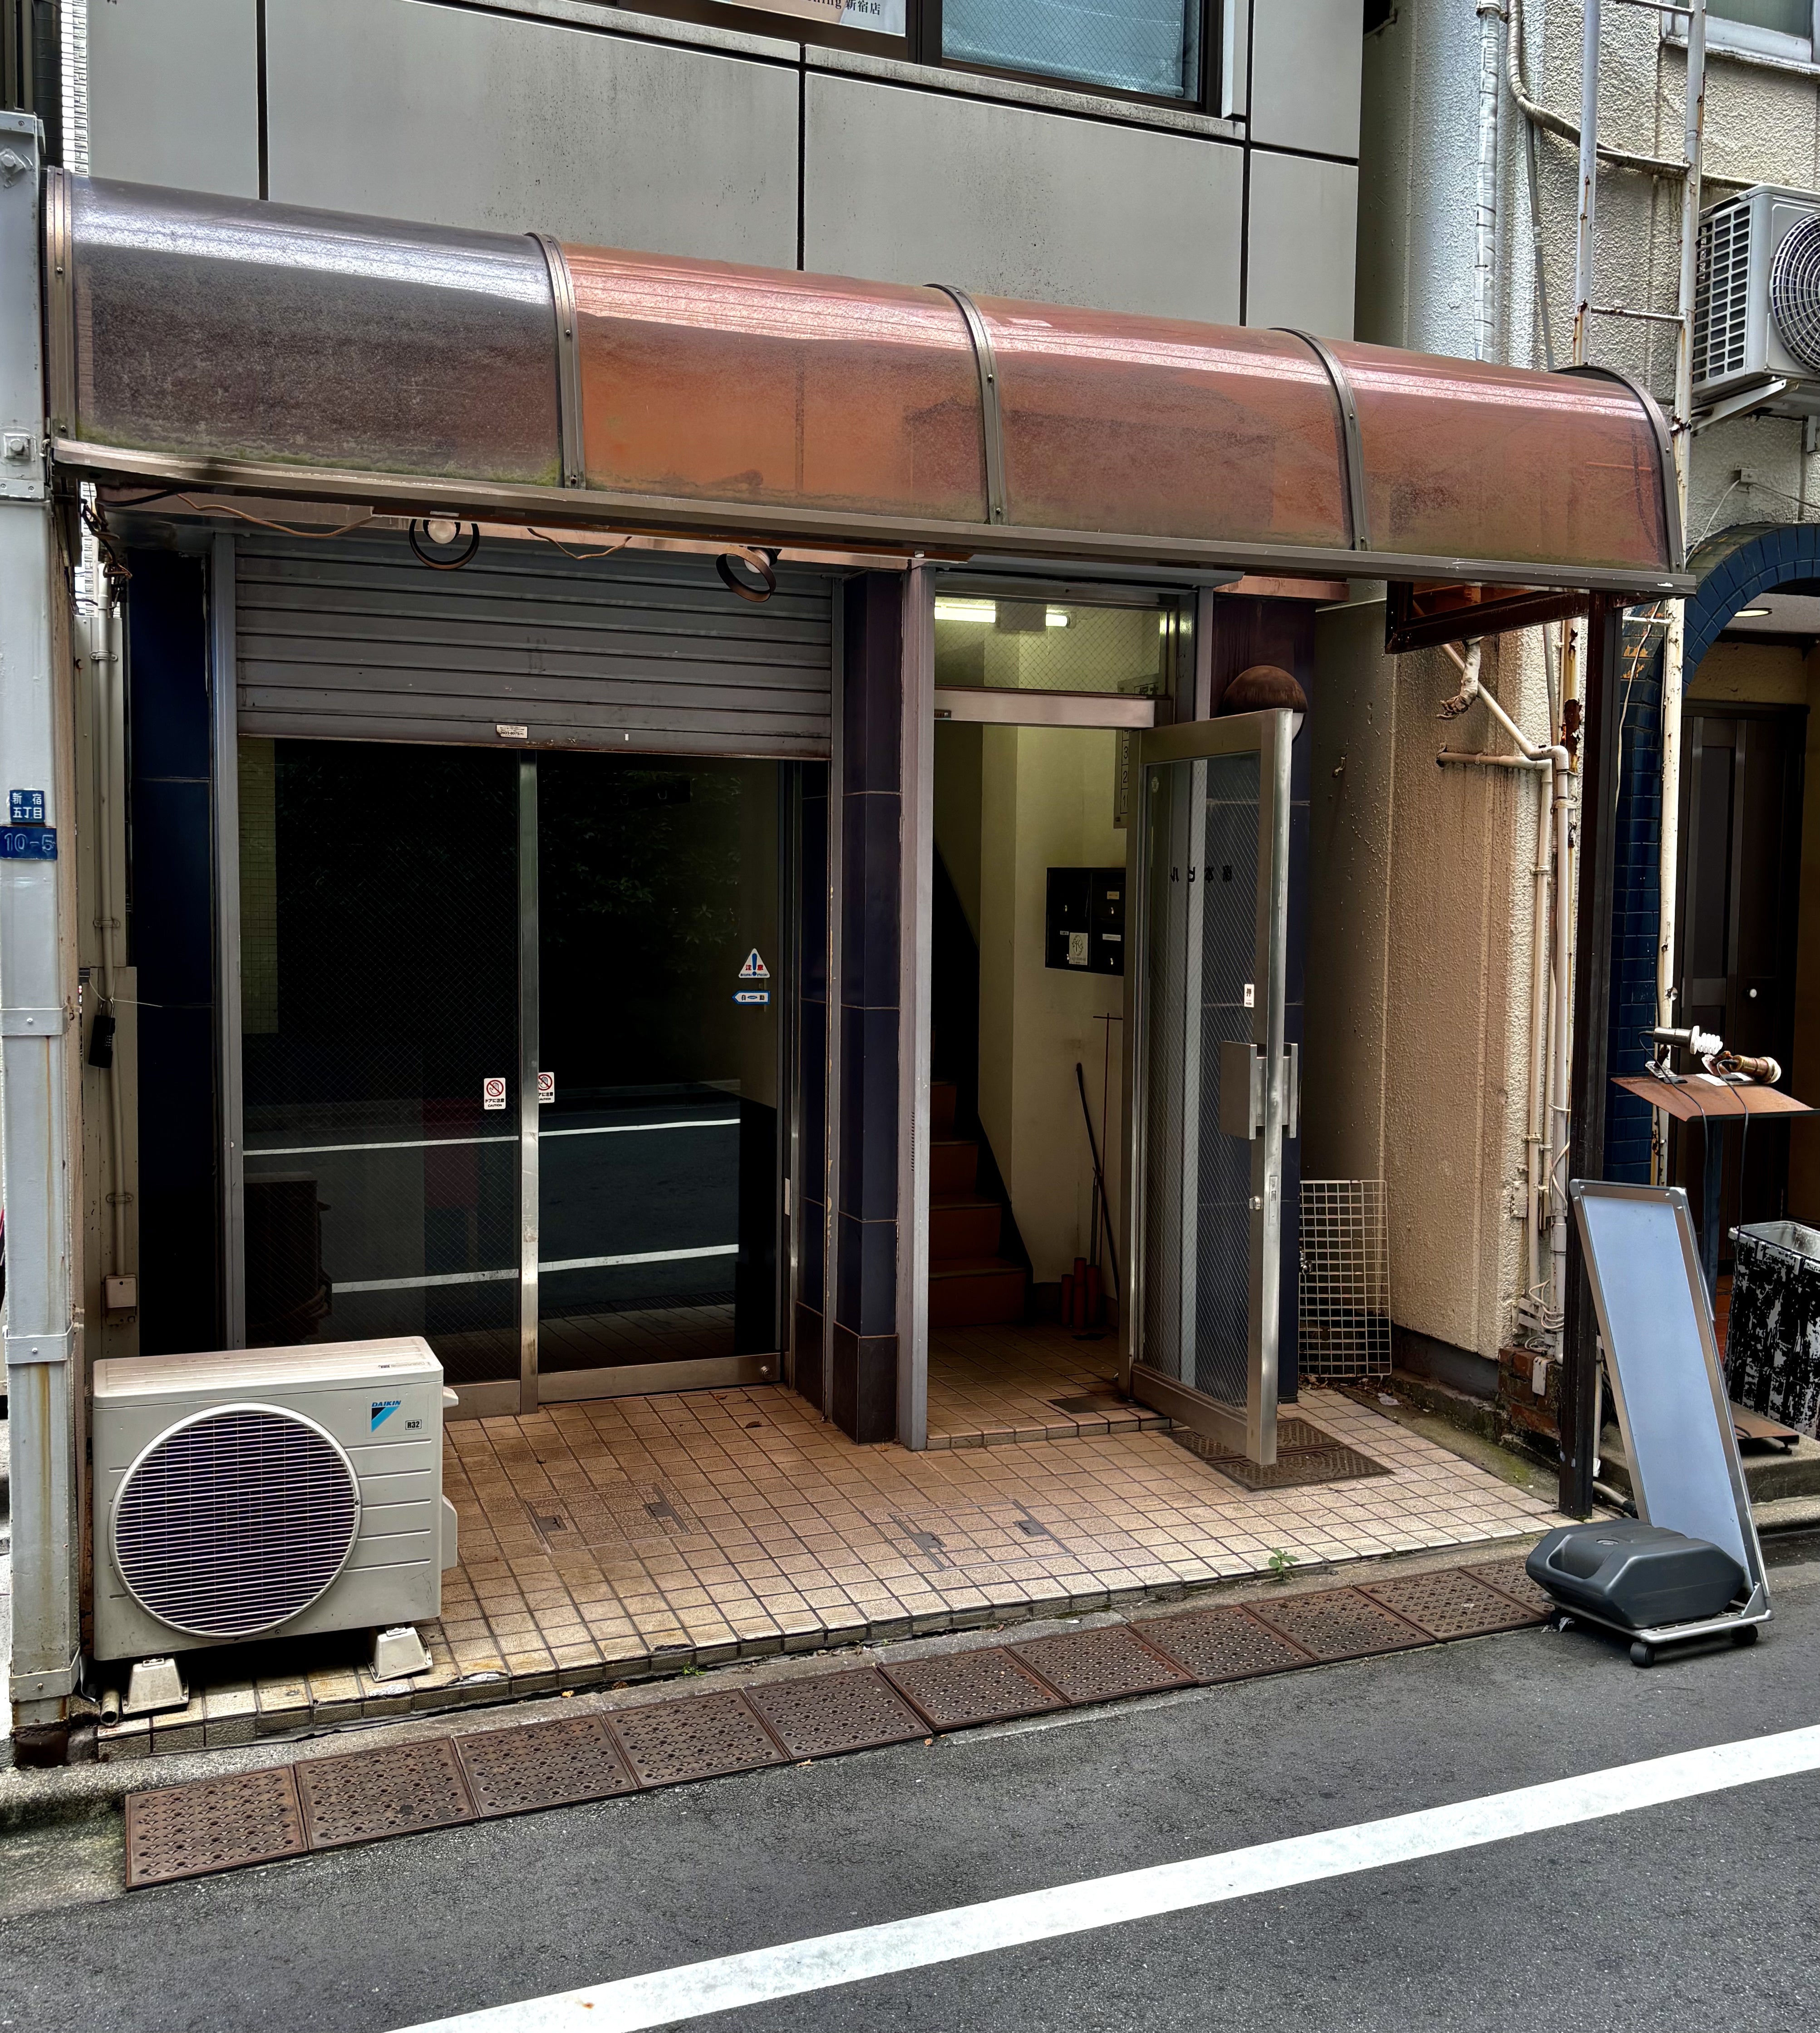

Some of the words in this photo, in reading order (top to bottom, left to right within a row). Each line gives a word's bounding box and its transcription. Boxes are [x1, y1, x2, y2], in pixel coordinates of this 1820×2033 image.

[846, 0, 880, 15] 新宿店
[12, 807, 42, 819] 五丁目
